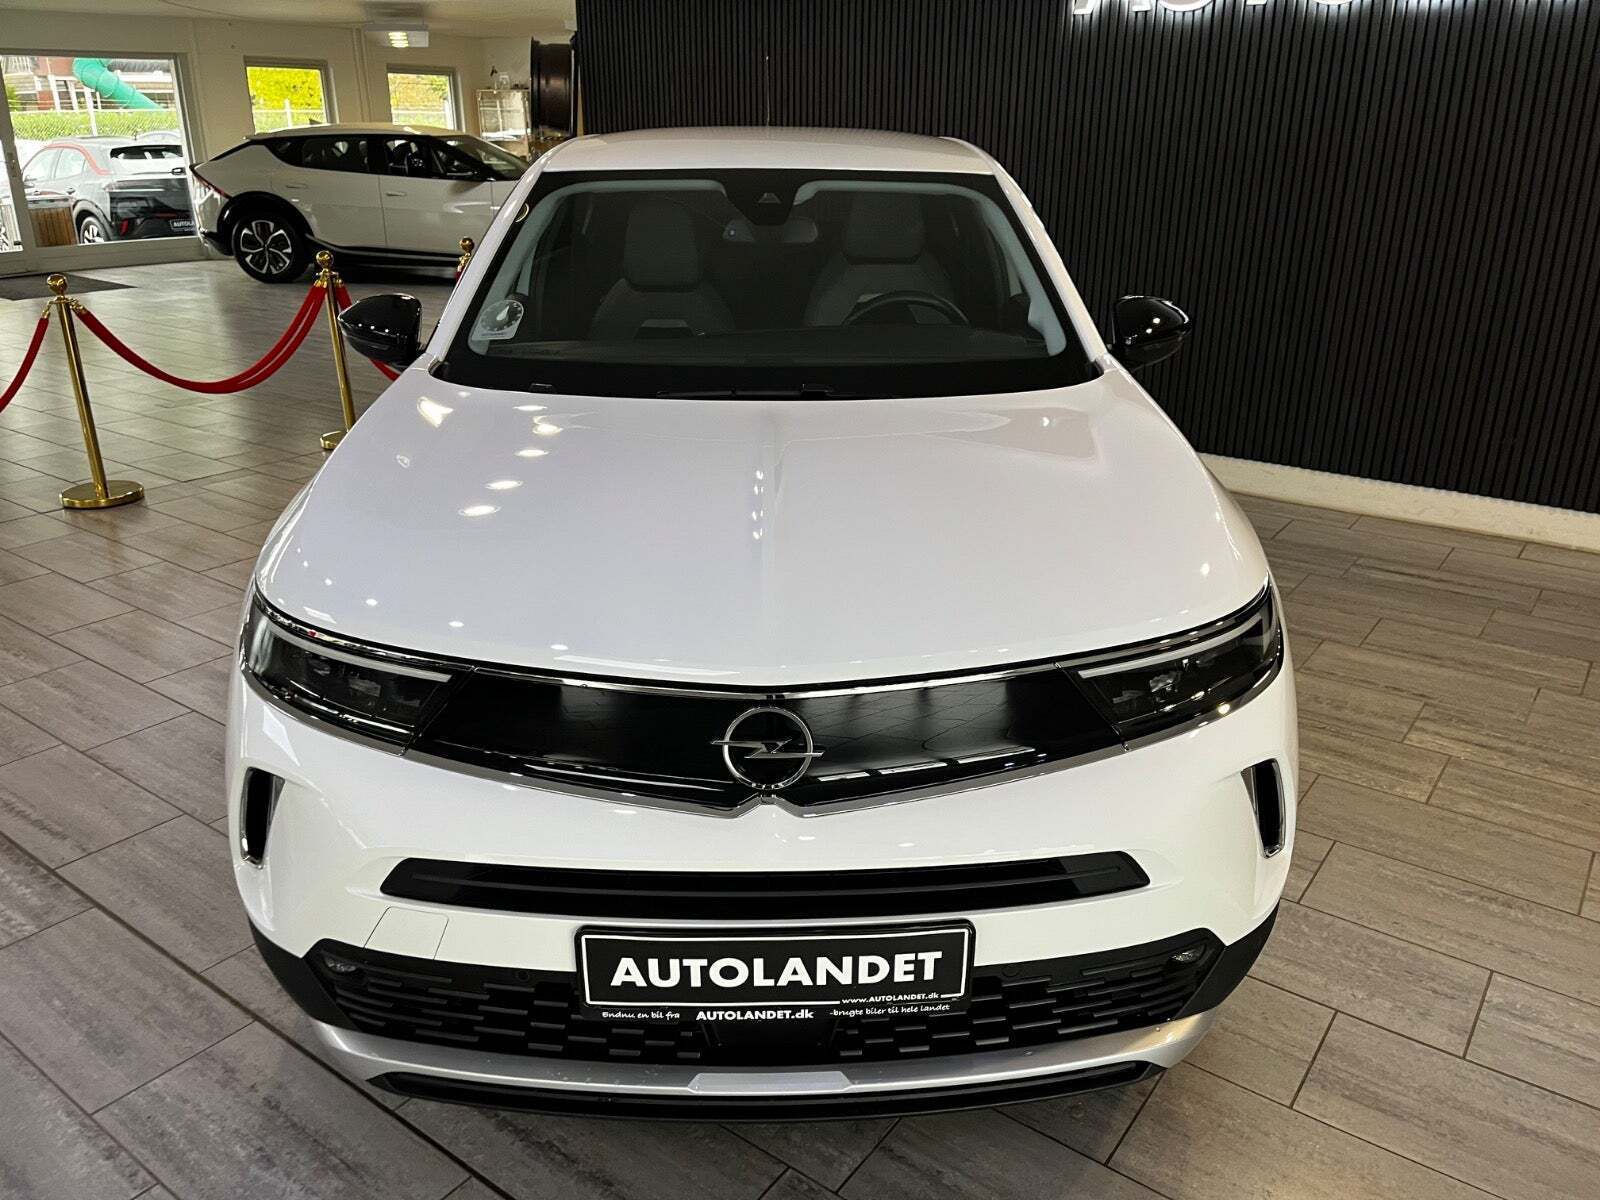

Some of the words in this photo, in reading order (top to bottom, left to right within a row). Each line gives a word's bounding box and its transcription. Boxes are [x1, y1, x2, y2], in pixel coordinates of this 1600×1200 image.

[610, 951, 943, 988] AUTOLANDET
[842, 992, 939, 1004] www.AUTOLANDET.dk
[696, 1009, 814, 1021] AUTOLANDET.dk
[865, 1006, 886, 1015] biler
[888, 1005, 899, 1014] til
[901, 1004, 918, 1013] hele
[920, 1003, 951, 1012] landet
[602, 1011, 636, 1019] Endnu
[651, 1010, 664, 1019] bil
[665, 1010, 680, 1021] fra
